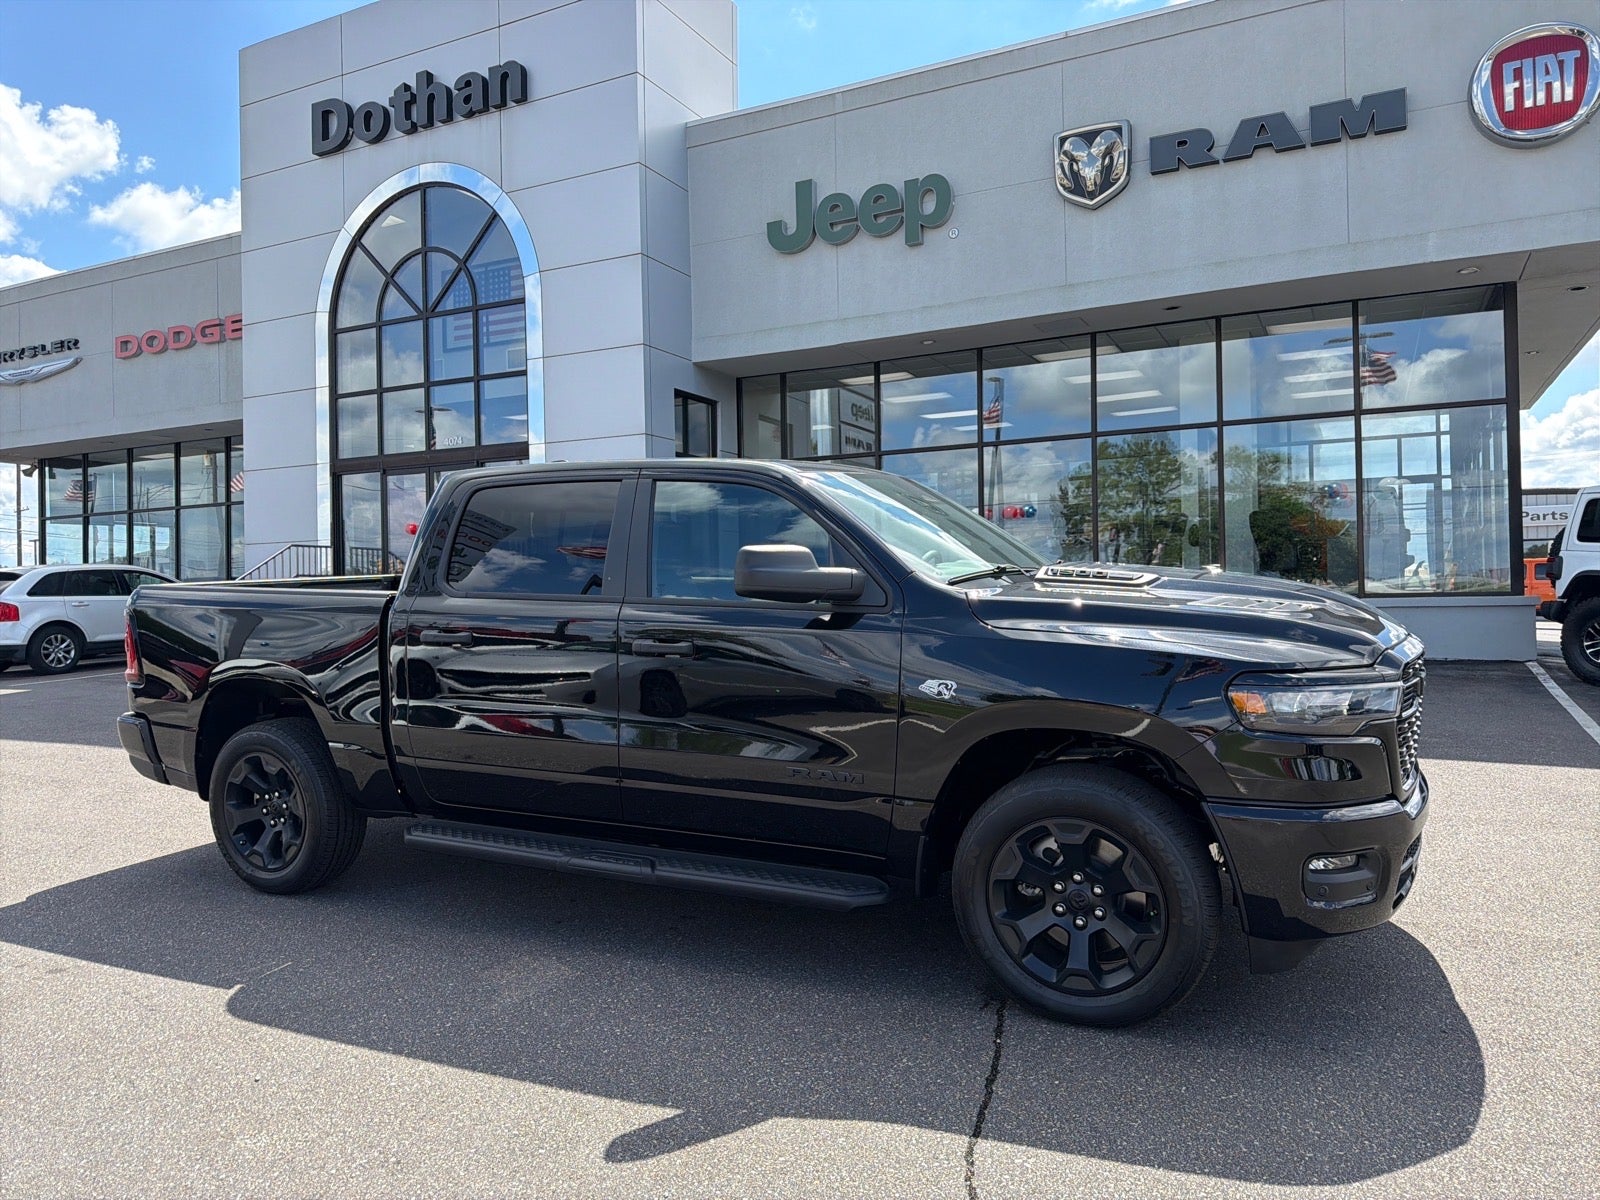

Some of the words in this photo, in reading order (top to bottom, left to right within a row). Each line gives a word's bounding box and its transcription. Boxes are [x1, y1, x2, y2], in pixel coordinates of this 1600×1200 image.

[1502, 50, 1580, 112] FIAT
[311, 59, 527, 157] Dothan
[1149, 87, 1407, 175] RAM
[766, 173, 954, 254] Jeep
[0, 337, 80, 363] RYSLER
[115, 313, 242, 359] DODGE
[444, 436, 463, 446] 4074
[1521, 511, 1569, 521] Parts
[786, 766, 864, 784] RAM
